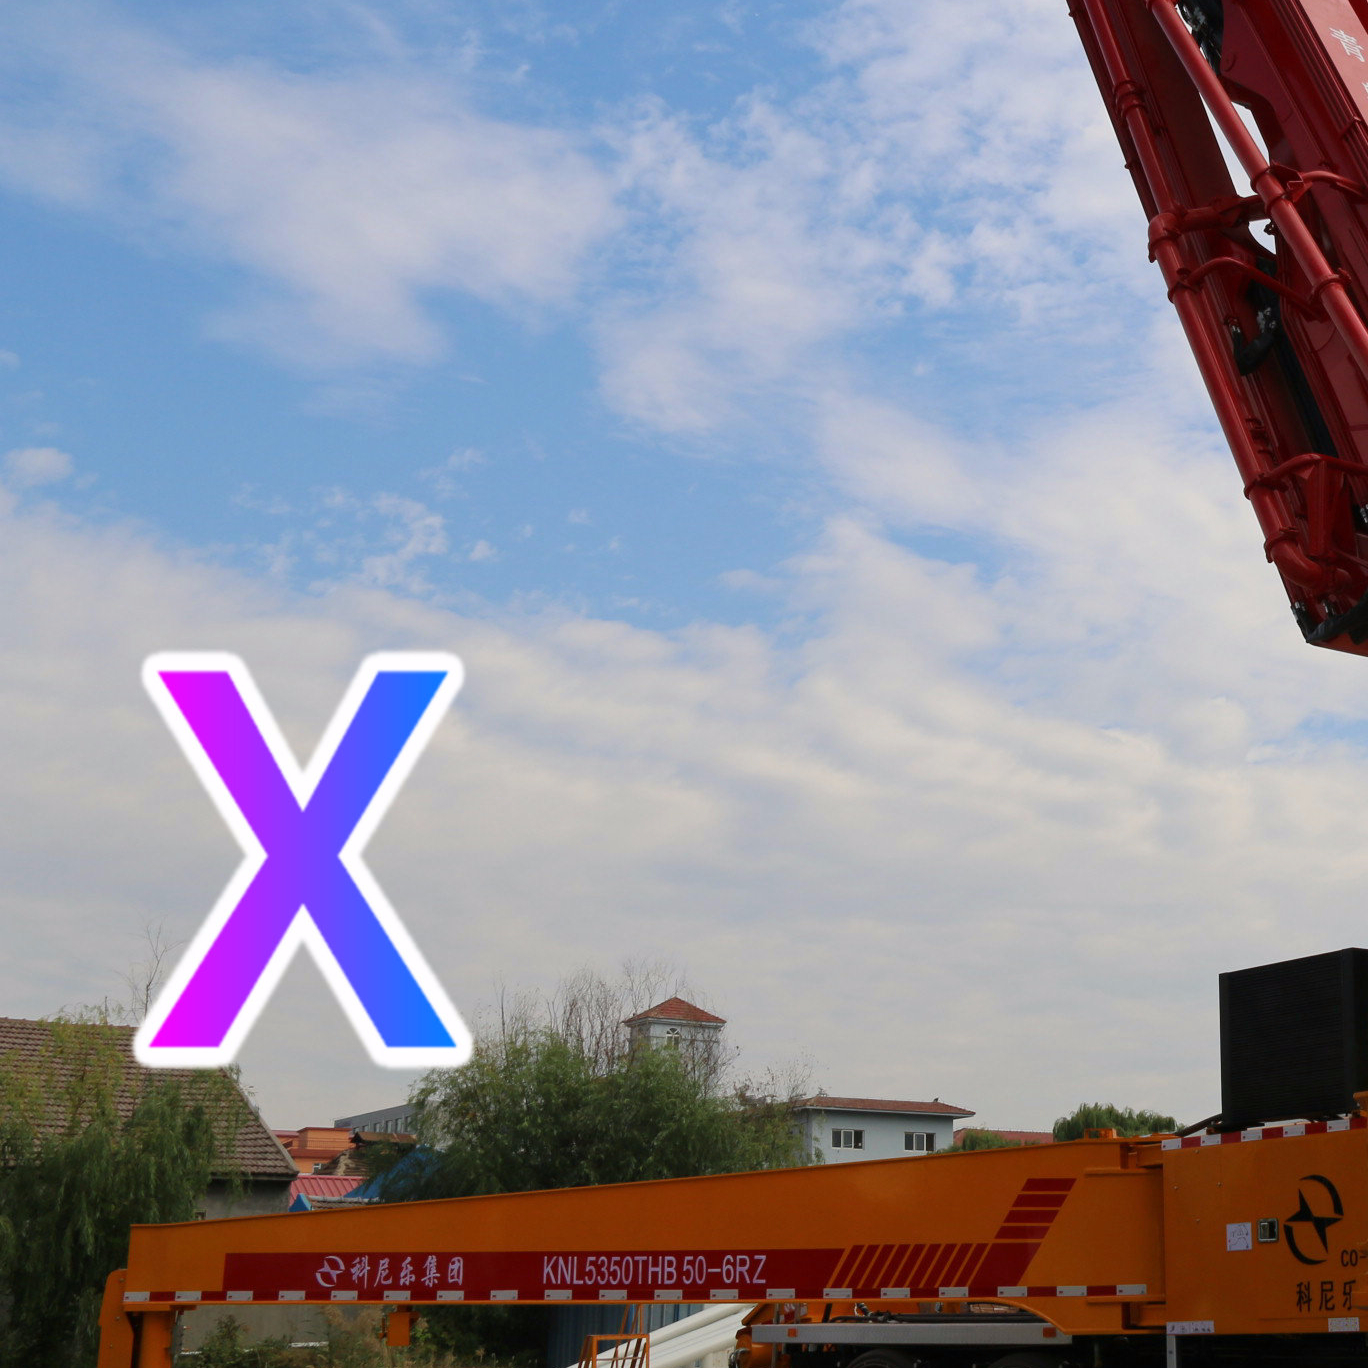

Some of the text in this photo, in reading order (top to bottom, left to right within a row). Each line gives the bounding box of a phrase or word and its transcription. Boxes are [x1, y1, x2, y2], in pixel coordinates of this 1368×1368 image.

[351, 1255, 463, 1289] 科尼乐集团
[543, 1255, 677, 1285] KNL5350THB
